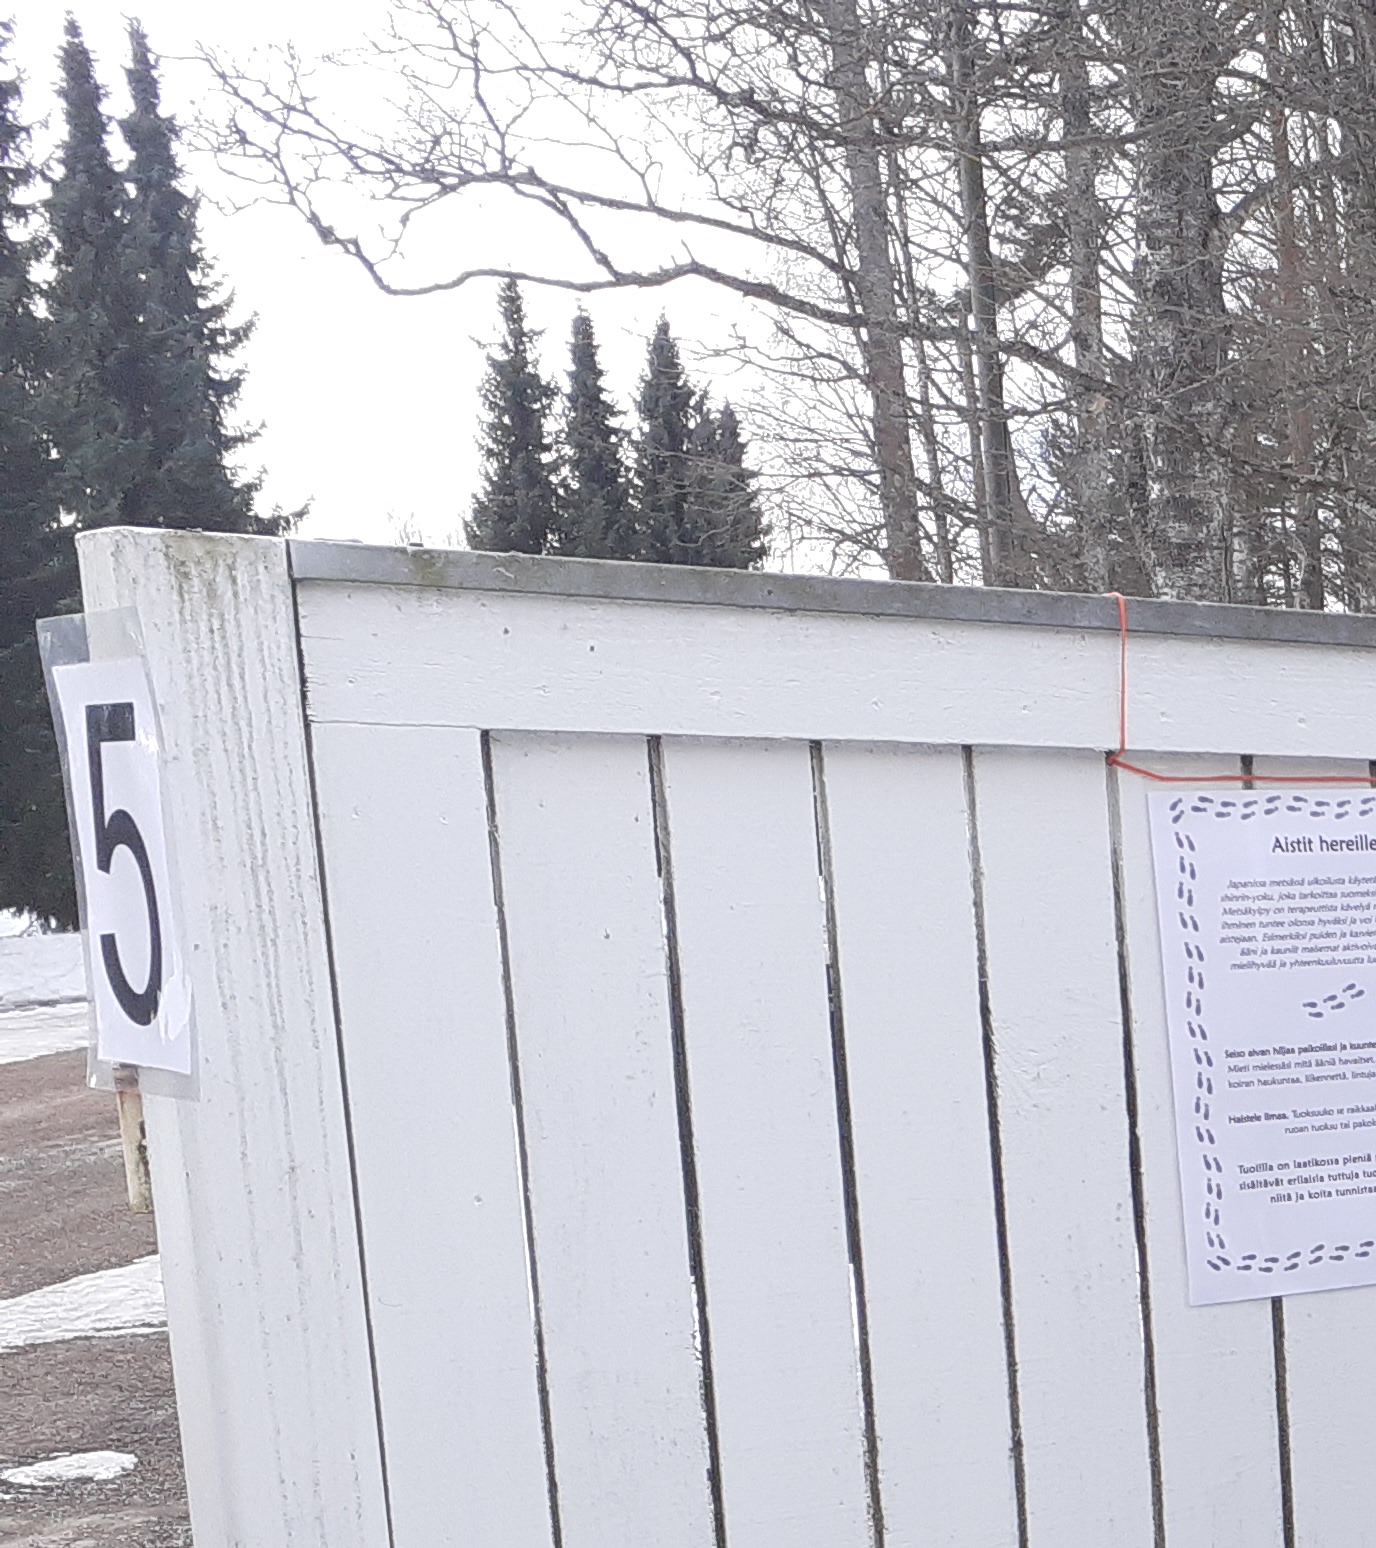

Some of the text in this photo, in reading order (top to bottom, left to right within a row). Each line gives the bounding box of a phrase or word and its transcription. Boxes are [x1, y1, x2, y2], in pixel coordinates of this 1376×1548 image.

[1272, 836, 1313, 853] Aistit
[86, 702, 163, 1026] 5
[1237, 1162, 1273, 1174] Tuolilla
[1276, 1162, 1290, 1170] on
[1293, 1157, 1339, 1168] laatikossa
[1342, 1152, 1371, 1166] pieniä
[1239, 1177, 1283, 1190] sisältävät
[1286, 1173, 1324, 1185] erilaisia
[1327, 1170, 1359, 1181] tuttuja
[1270, 1192, 1292, 1202] niitä
[1295, 1191, 1304, 1202] ja
[1307, 1189, 1332, 1199] koita
